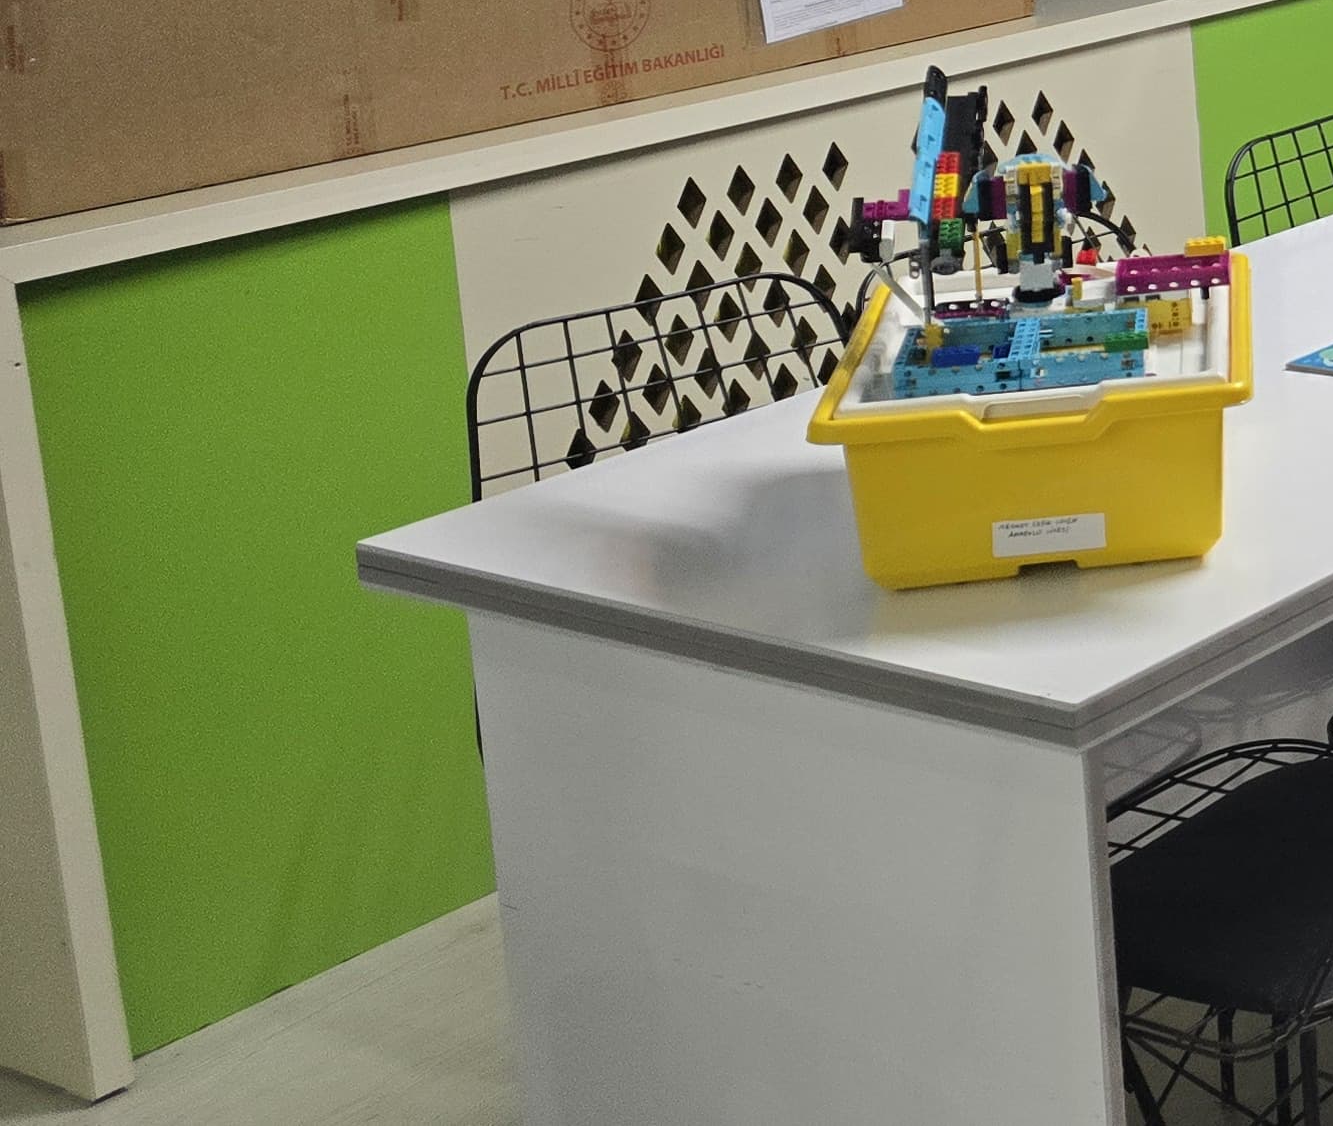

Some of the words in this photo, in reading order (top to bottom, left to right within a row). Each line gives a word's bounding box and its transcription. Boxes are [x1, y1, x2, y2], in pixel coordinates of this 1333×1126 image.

[499, 81, 532, 100] T.C.
[536, 68, 580, 93] MİLLİ
[583, 60, 638, 84] EĞİTİM
[642, 42, 725, 72] BAKANLIĞI
